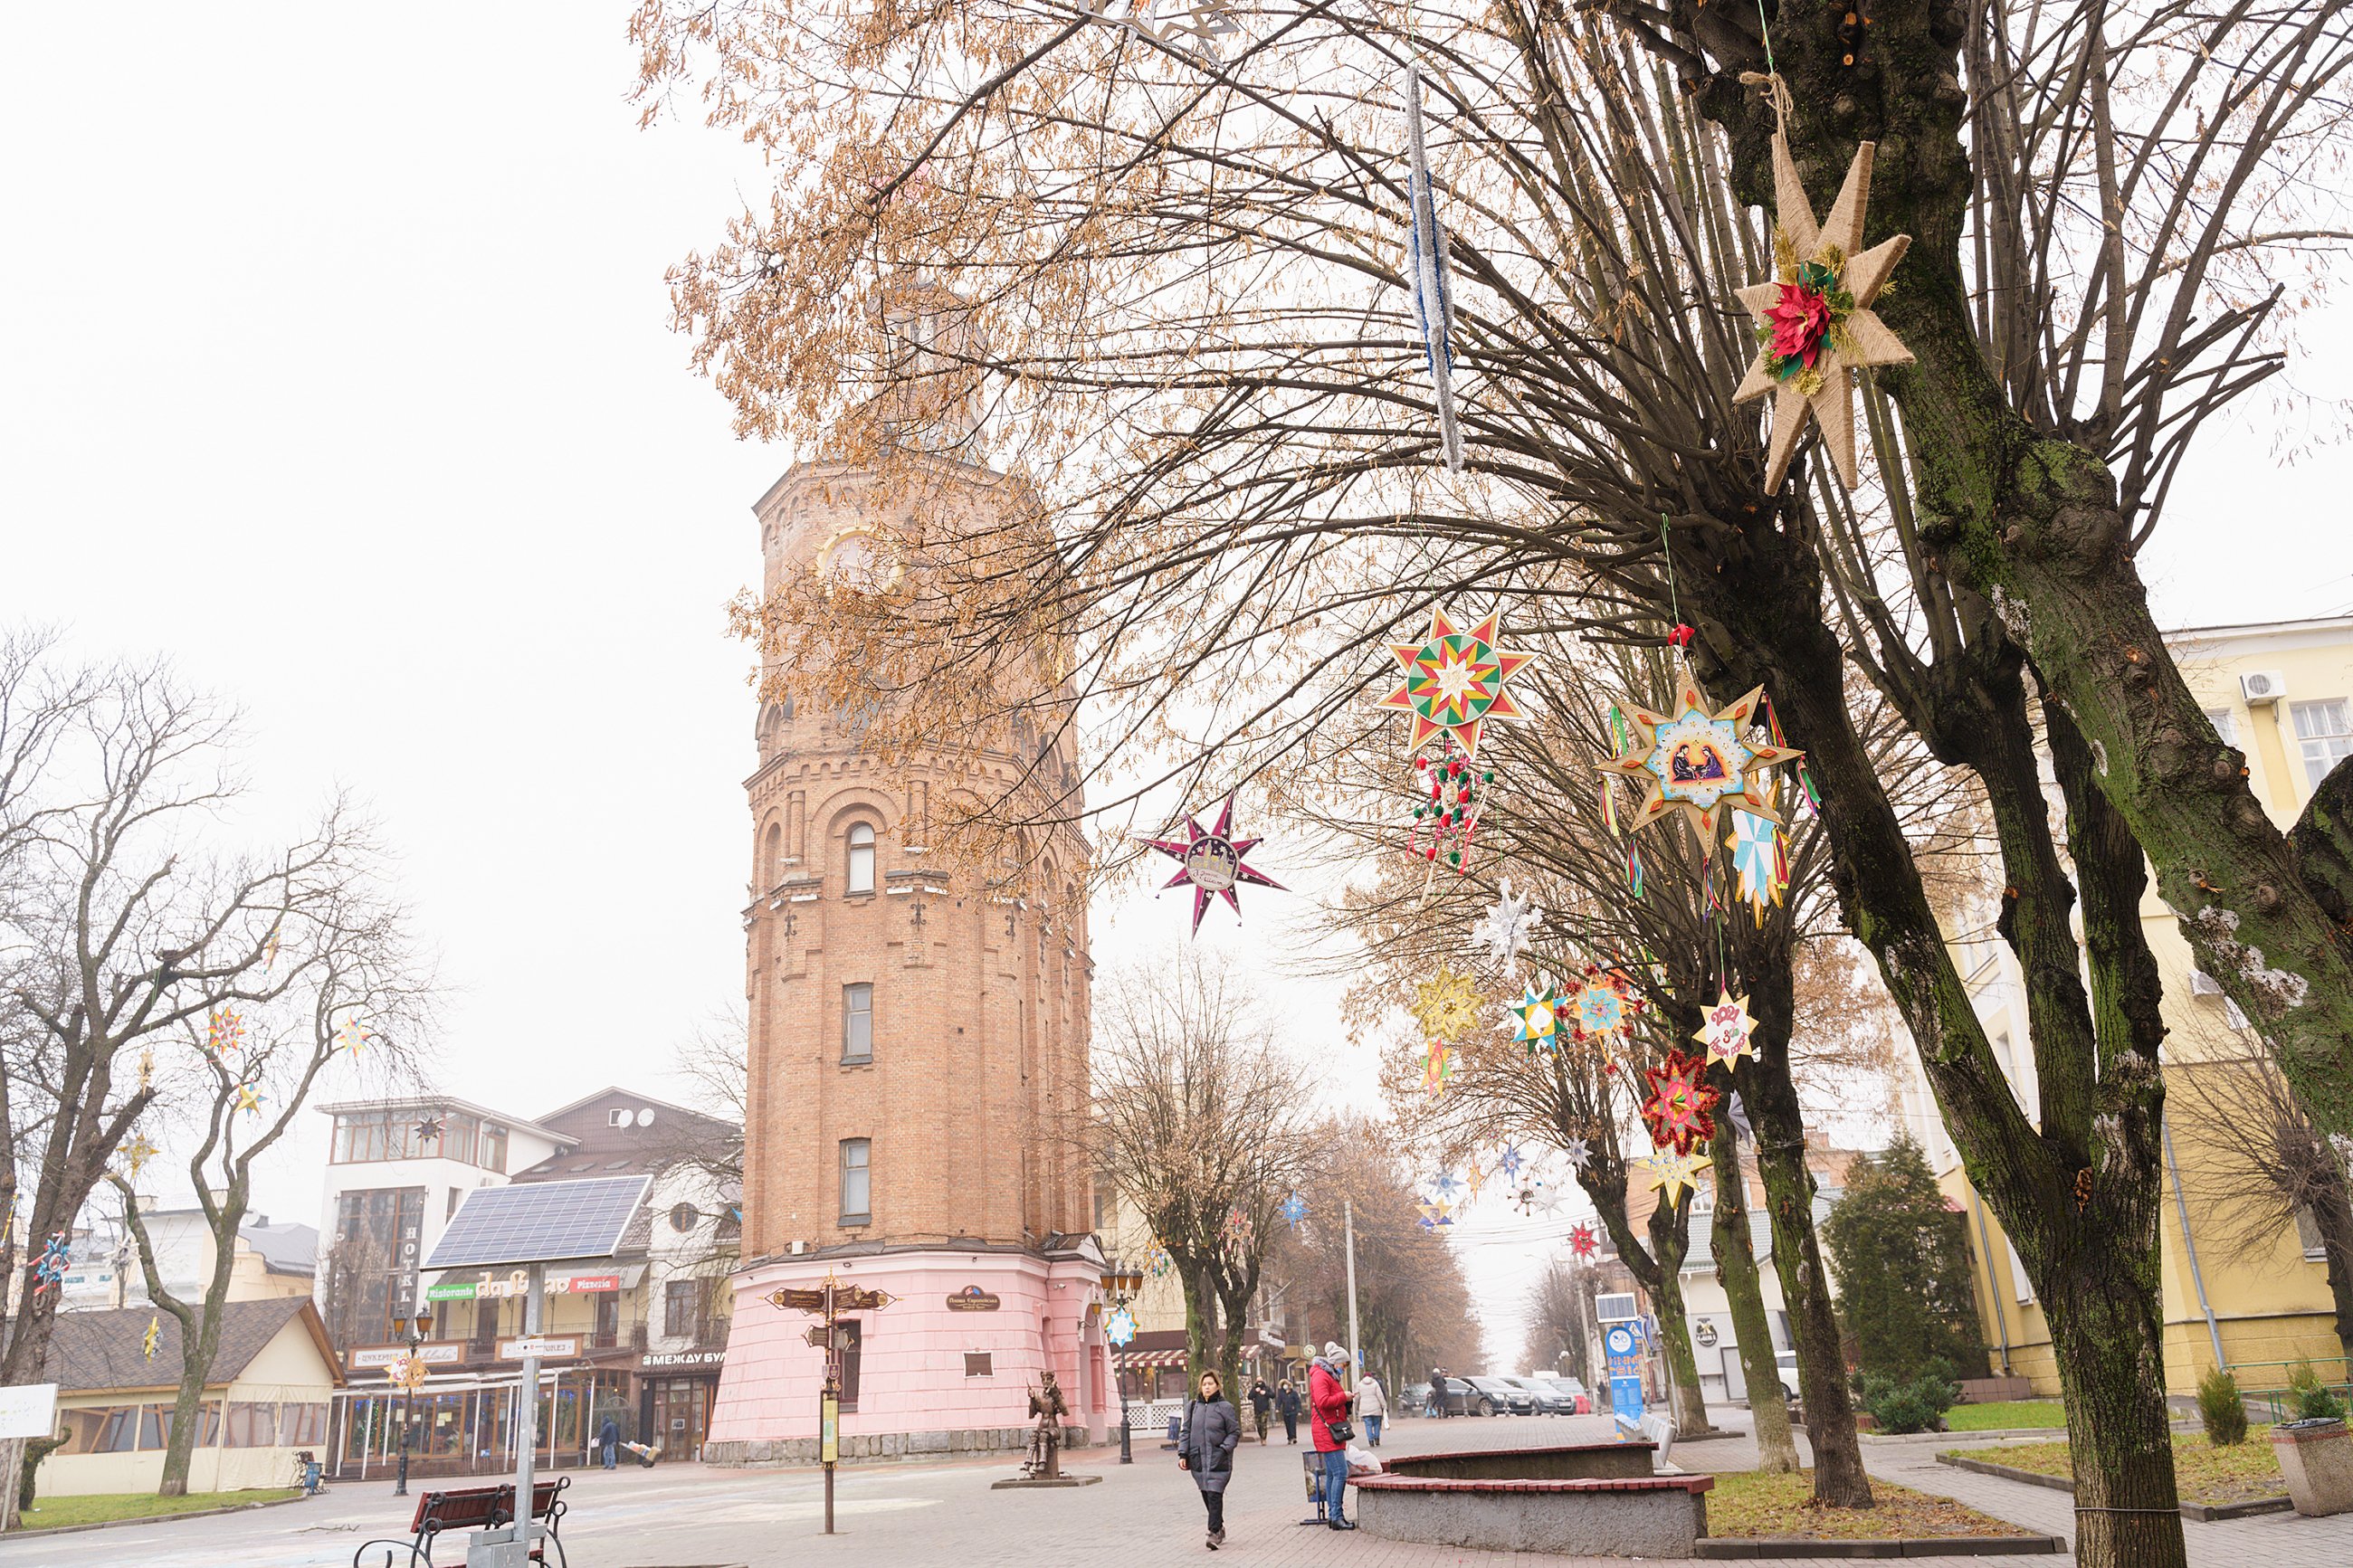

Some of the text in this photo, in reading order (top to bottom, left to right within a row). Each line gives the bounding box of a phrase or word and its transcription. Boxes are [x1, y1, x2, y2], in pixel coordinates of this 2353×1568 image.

[1710, 1005, 1740, 1027] 2021
[428, 1285, 474, 1298] Ristorante
[576, 1278, 612, 1289] Pizzeria
[652, 1353, 703, 1365] МЕЖДУ
